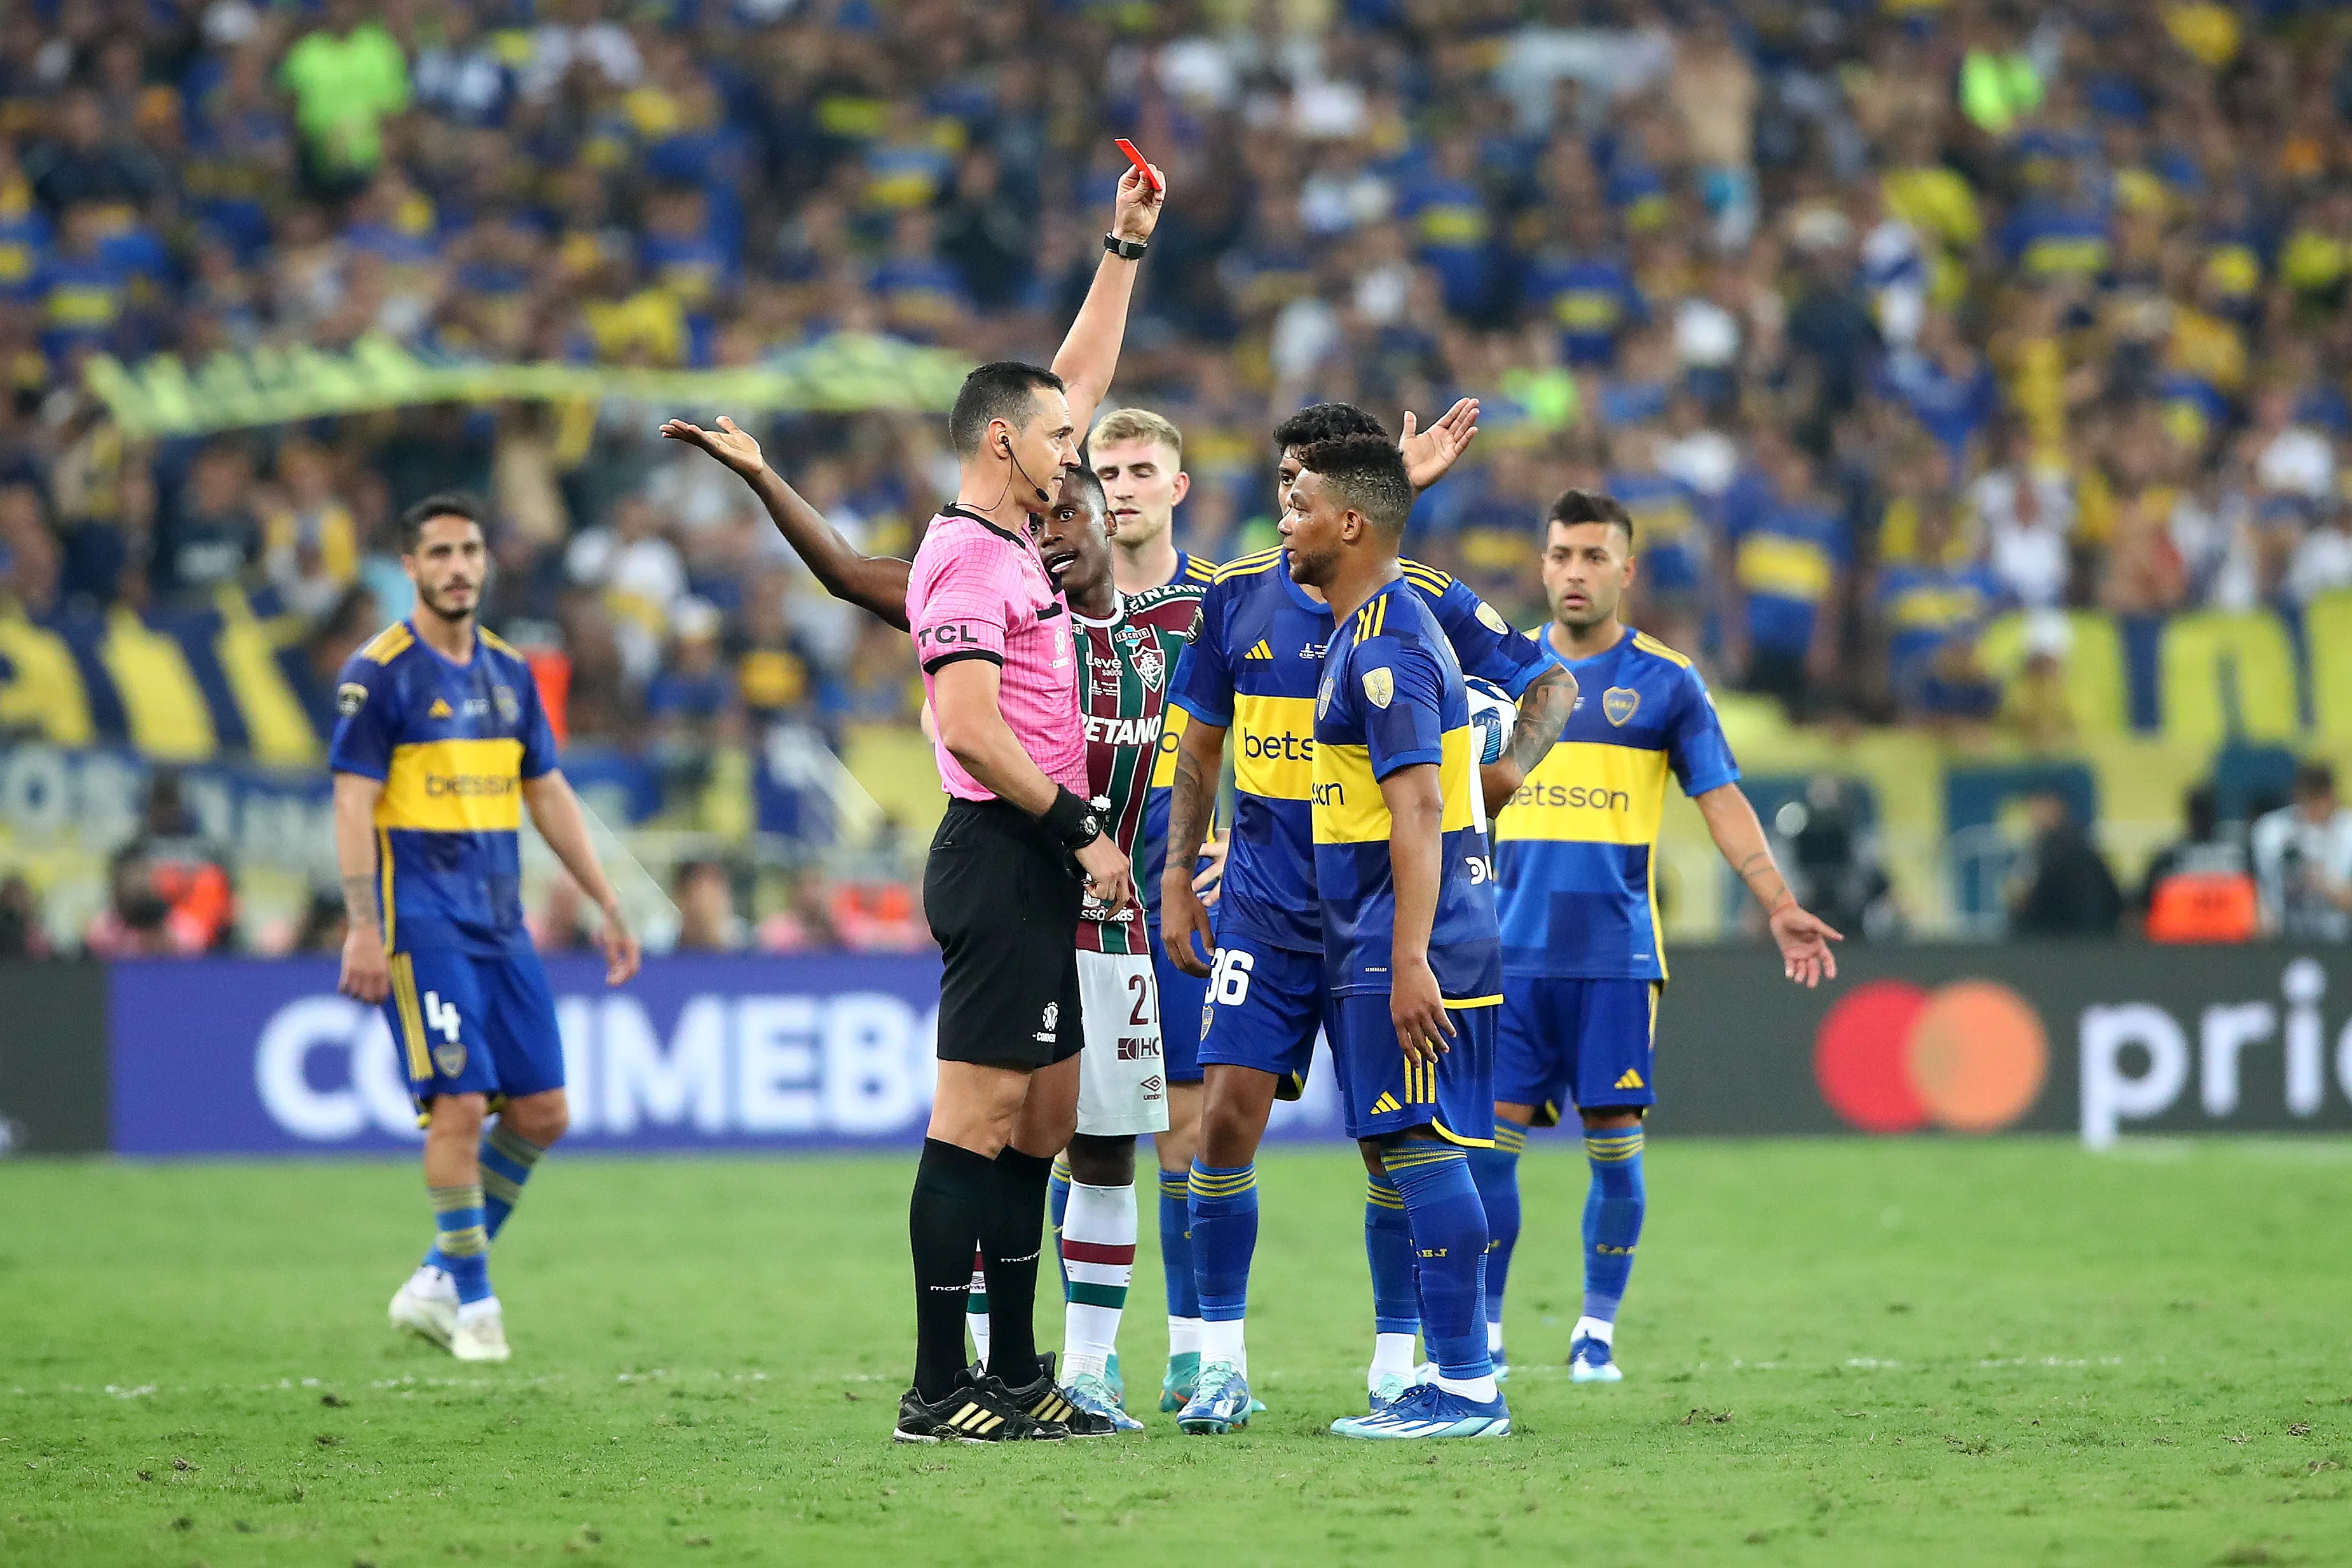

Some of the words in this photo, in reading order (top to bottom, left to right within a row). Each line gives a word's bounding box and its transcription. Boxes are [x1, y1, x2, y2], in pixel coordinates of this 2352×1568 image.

[919, 625, 978, 648] TCL
[1086, 651, 1123, 669] Leve
[1204, 947, 1255, 1006] 36
[424, 990, 462, 1043] 4
[256, 993, 939, 1140] CMEB
[2079, 958, 2352, 1152] pri
